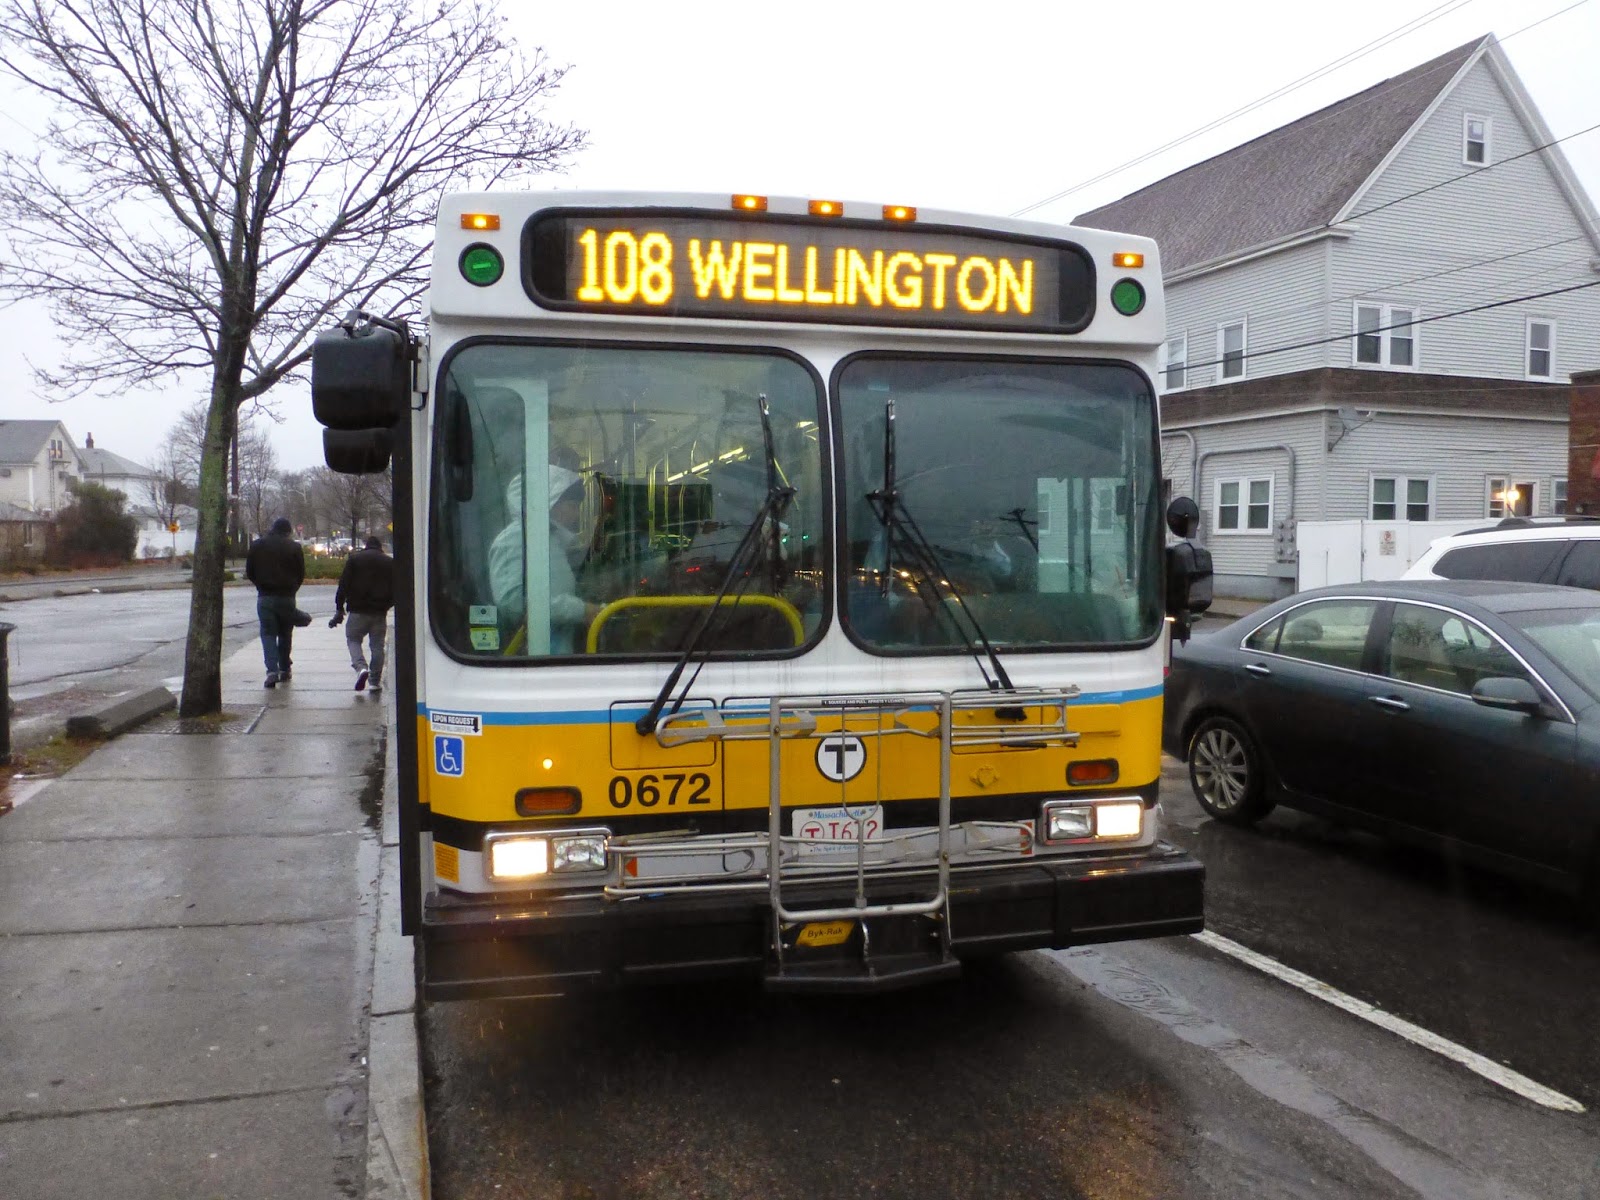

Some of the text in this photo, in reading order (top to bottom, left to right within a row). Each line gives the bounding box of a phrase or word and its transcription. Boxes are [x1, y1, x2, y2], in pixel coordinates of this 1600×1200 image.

[577, 228, 1034, 314] 108 WELLINGTON
[433, 714, 474, 725] UPON REQUEST
[824, 744, 857, 774] T
[608, 773, 711, 808] 0672
[807, 928, 843, 938] Byk-Rak
